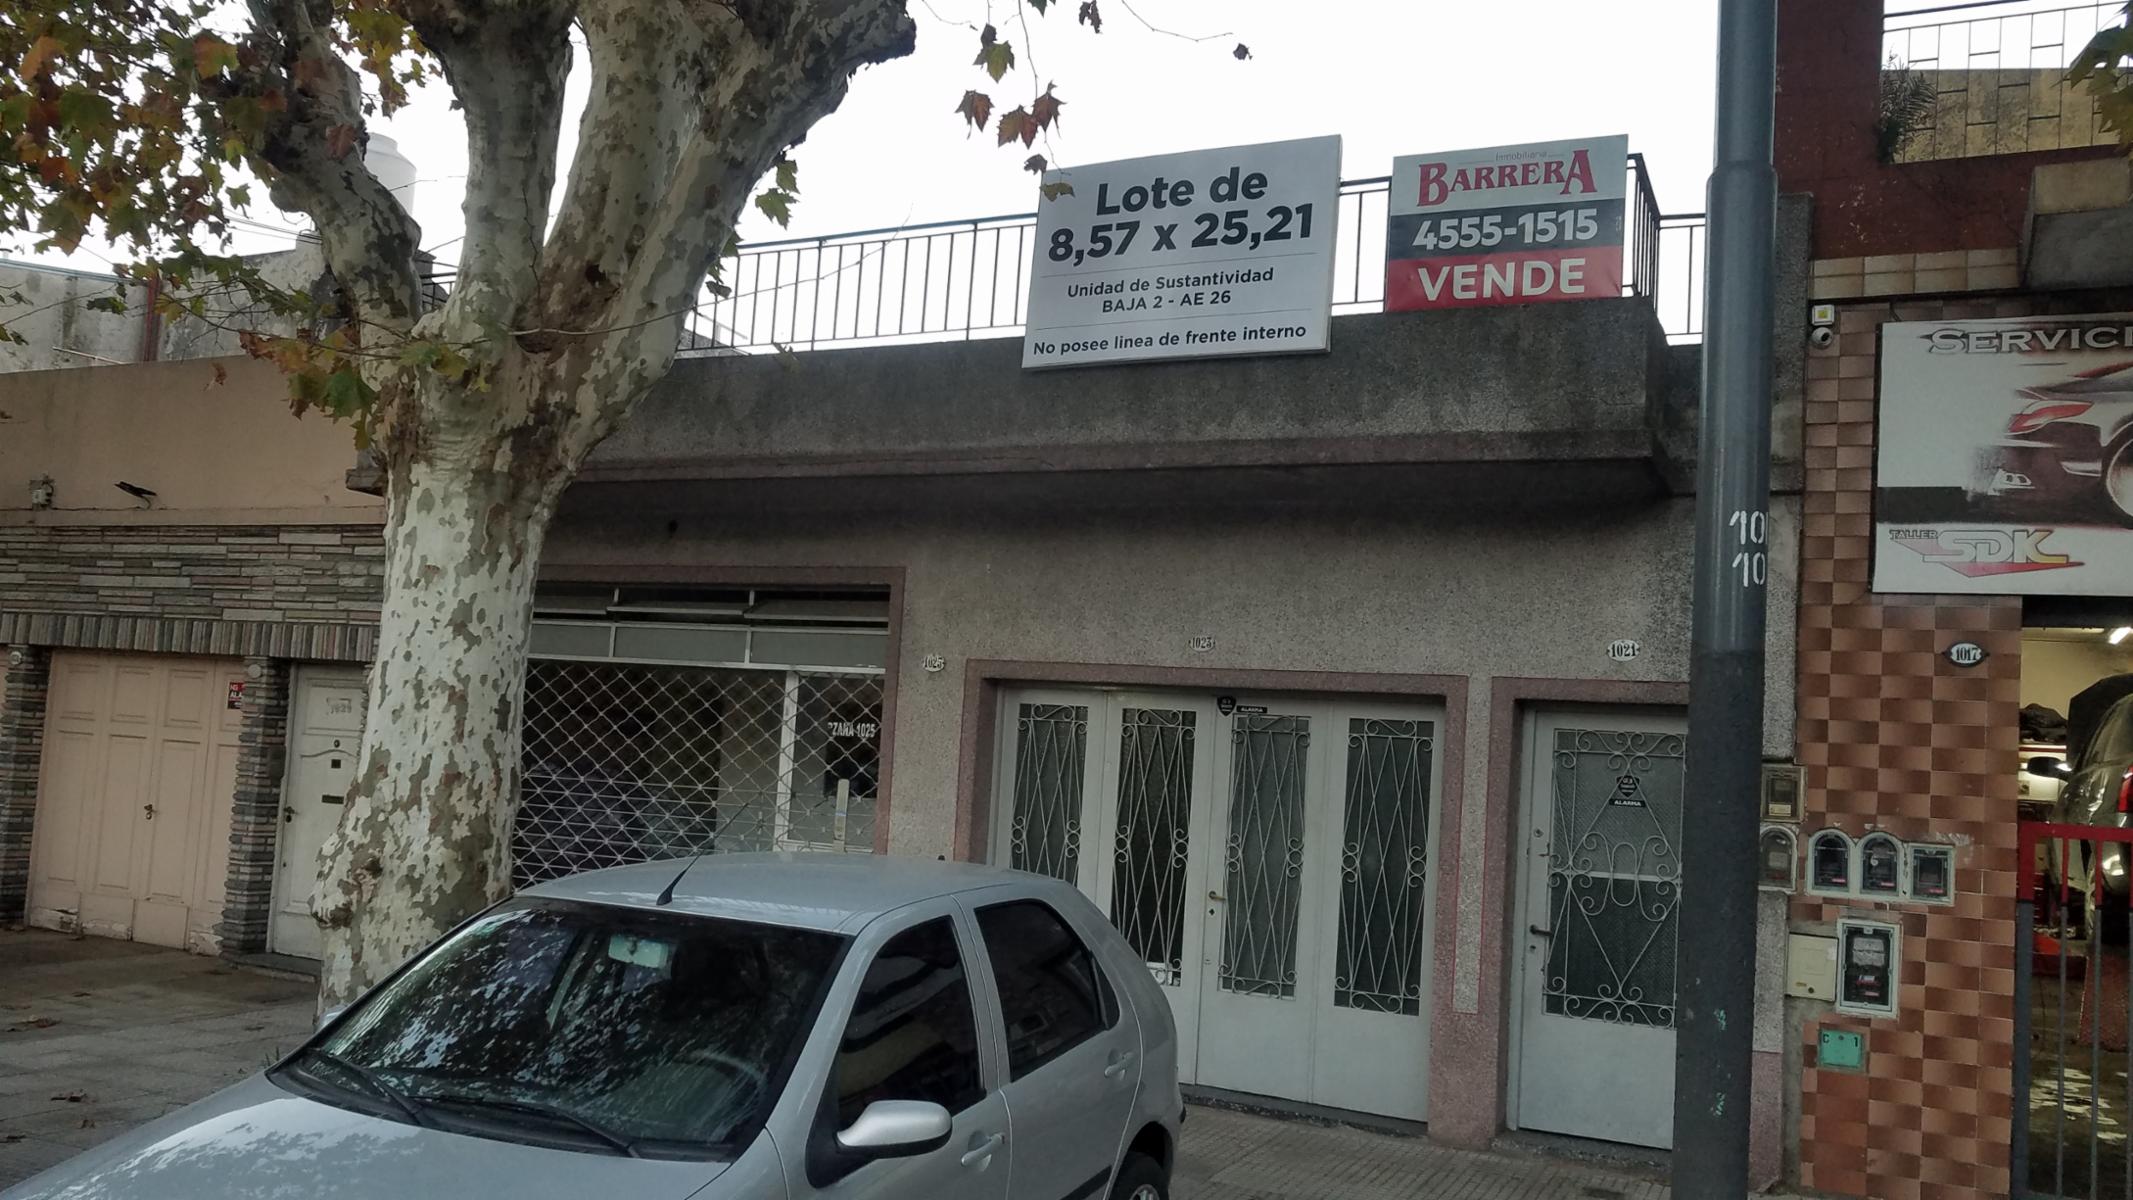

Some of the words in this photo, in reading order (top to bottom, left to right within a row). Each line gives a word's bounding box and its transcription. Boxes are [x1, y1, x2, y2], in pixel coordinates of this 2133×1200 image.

[1096, 177, 1195, 216] Lote
[1209, 167, 1268, 203] de
[1417, 149, 1598, 207] BARRERA
[1048, 220, 1141, 267] 8,57
[1151, 223, 1178, 252] x
[1191, 203, 1313, 250] 25,21
[1412, 208, 1598, 251] 4555-1515
[1067, 280, 1124, 298] Unidad
[1129, 278, 1150, 292] de
[1155, 267, 1274, 290] Sustantividad
[1418, 258, 1586, 301] VENDE
[1102, 296, 1147, 313] BAJA
[1153, 295, 1163, 309] 2
[1180, 292, 1204, 307] AE
[1210, 290, 1231, 304] 26
[1033, 341, 1055, 355] No
[1060, 339, 1108, 356] posee
[1114, 335, 1153, 350] linea
[1159, 332, 1180, 346] de
[1186, 328, 1236, 345] frente
[1242, 324, 1306, 341] interno
[1889, 529, 1938, 541] TALLER
[1923, 529, 2070, 564] SDK
[1731, 551, 1766, 588] 10
[1611, 643, 1636, 658] 1021
[1956, 646, 1978, 661] 1017
[856, 722, 876, 738] 1025
